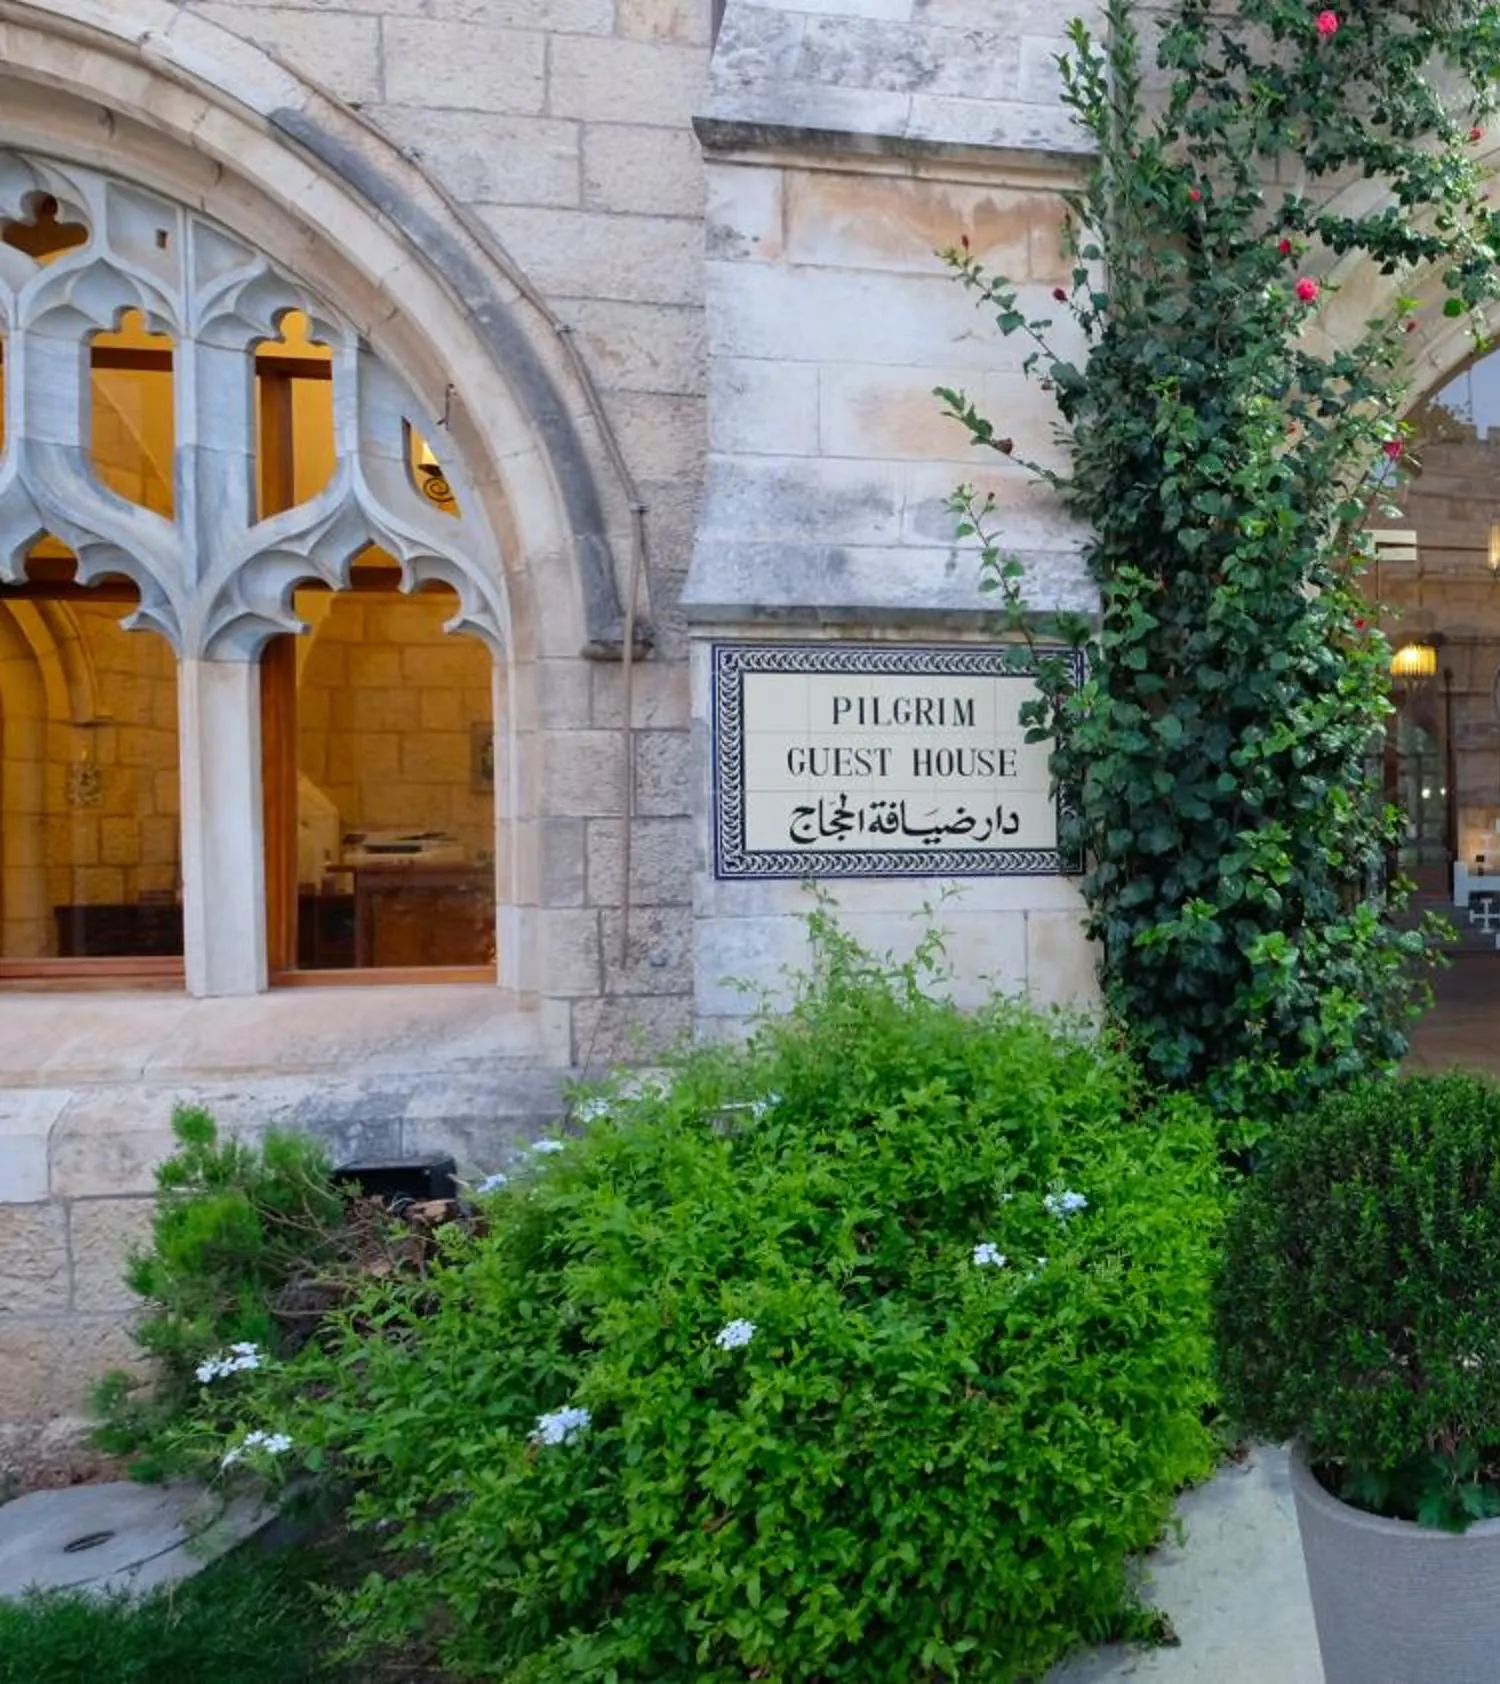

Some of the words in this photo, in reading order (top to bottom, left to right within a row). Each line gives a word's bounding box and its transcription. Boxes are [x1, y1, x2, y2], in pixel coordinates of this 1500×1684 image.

[832, 696, 976, 727] PILGRIM
[787, 747, 893, 777] GUEST
[913, 747, 1018, 777] HOUSE
[971, 803, 1020, 843] دار
